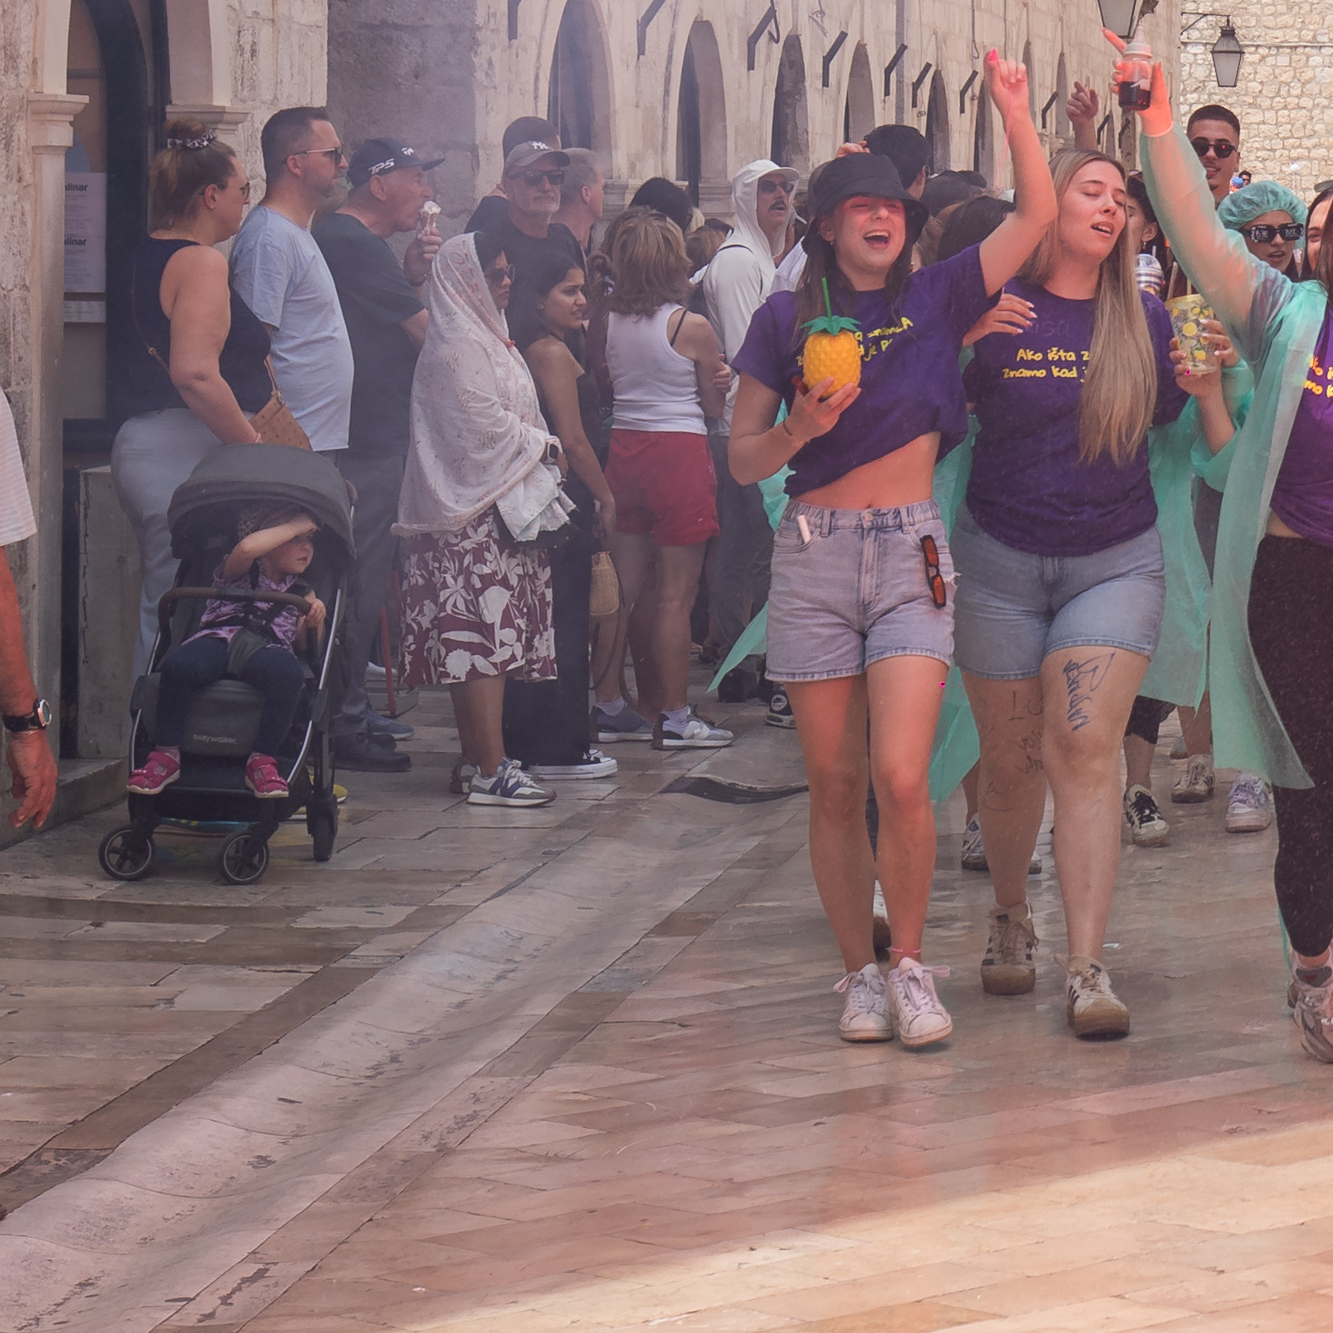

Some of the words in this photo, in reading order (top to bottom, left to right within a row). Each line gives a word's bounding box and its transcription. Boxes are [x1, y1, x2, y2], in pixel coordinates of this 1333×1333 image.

[1016, 349, 1043, 362] Ako
[1047, 347, 1076, 361] išta
[1002, 368, 1047, 379] znamo
[1051, 366, 1078, 378] kad
